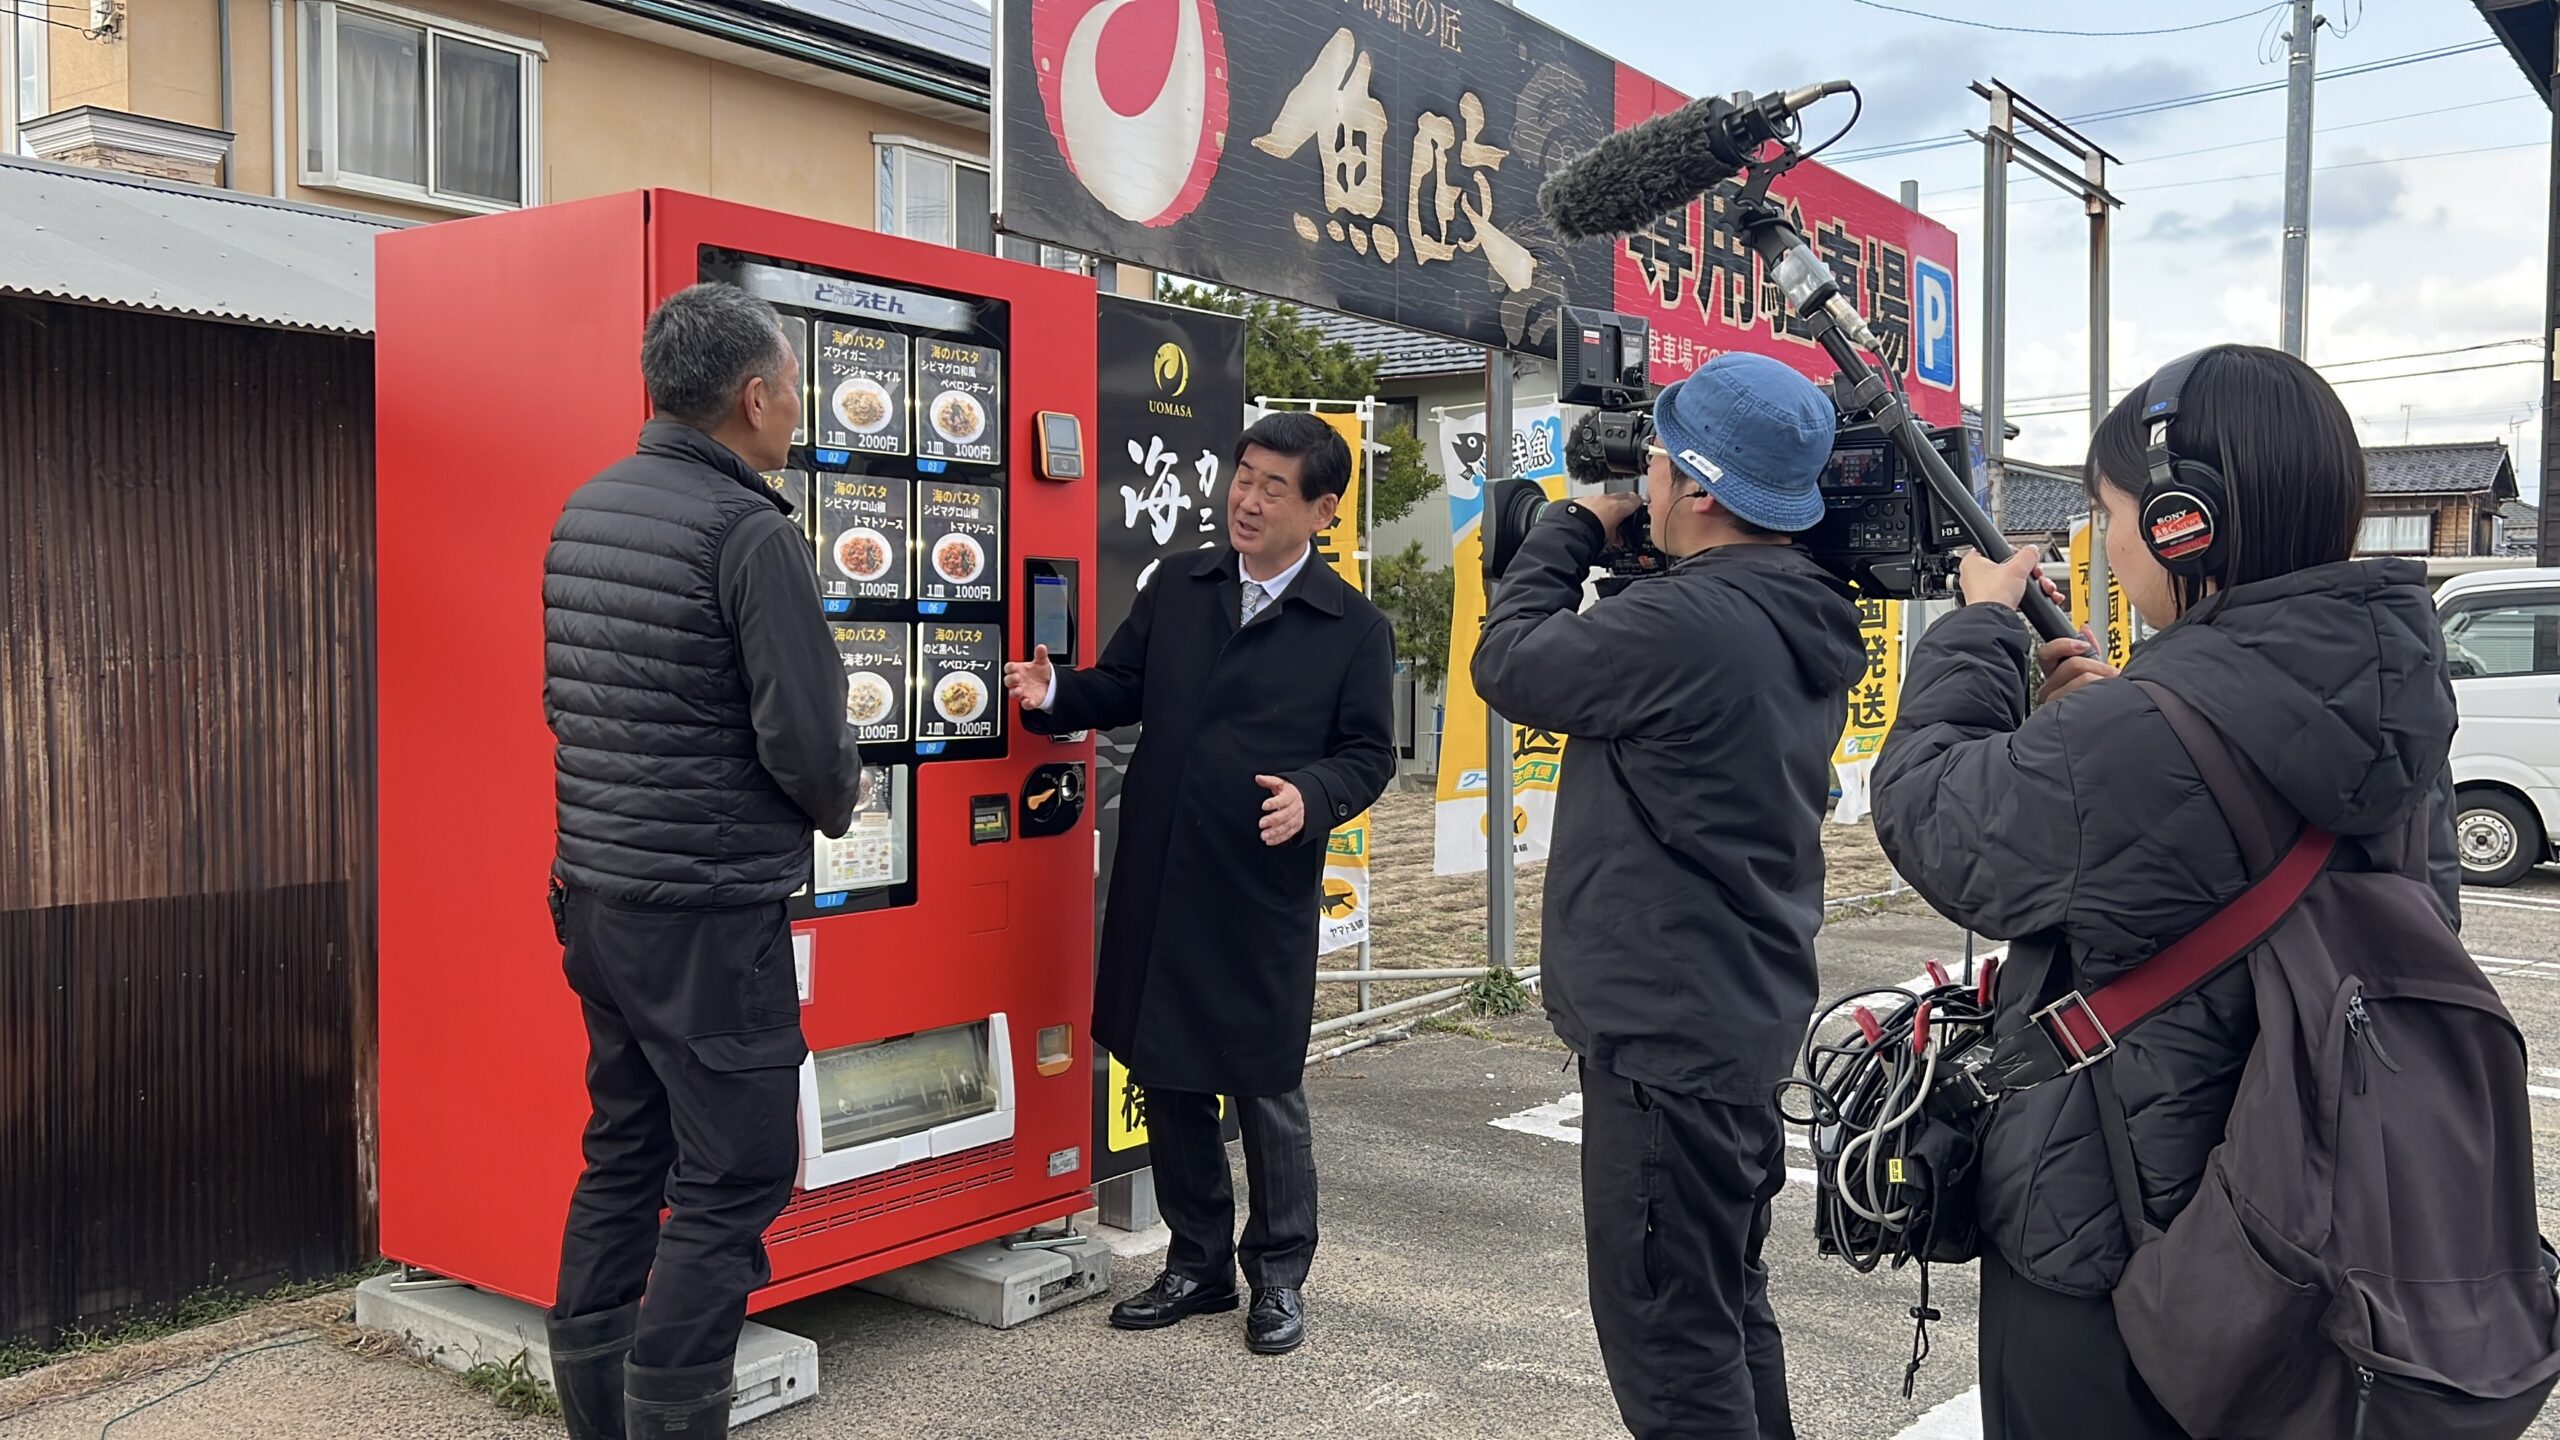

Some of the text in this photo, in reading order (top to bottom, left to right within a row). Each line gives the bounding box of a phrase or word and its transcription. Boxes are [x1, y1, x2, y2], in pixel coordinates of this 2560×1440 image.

[1921, 272, 1947, 371] P
[832, 330, 886, 350] 海のパスタ
[823, 346, 867, 362] ズワイガニ
[931, 345, 980, 365] 海のパスタ
[832, 364, 901, 383] ジンジャーオイル
[1148, 400, 1193, 418] UOMASA
[827, 431, 899, 452] 1皿 2000円
[827, 450, 839, 463] 02
[927, 441, 991, 461] 1皿 1000円
[927, 461, 939, 473] 03
[833, 480, 888, 499] 海のパスタ
[932, 489, 981, 507] 海のパスタ
[1194, 449, 1219, 550] カニ
[1120, 435, 1192, 592] 海
[853, 514, 904, 530] トマトソース
[950, 520, 995, 535] トマトソース
[2155, 521, 2177, 537] ABC
[827, 581, 899, 598] 1皿 1000円
[926, 583, 991, 600] 1皿 1000円
[828, 601, 840, 613] 05
[928, 603, 939, 615] 06
[834, 628, 886, 643] 海のパスタ
[934, 628, 984, 643] 海のパスタ
[858, 724, 898, 740] 1000円
[926, 721, 991, 737] 1皿 1000円
[926, 743, 938, 755] 09
